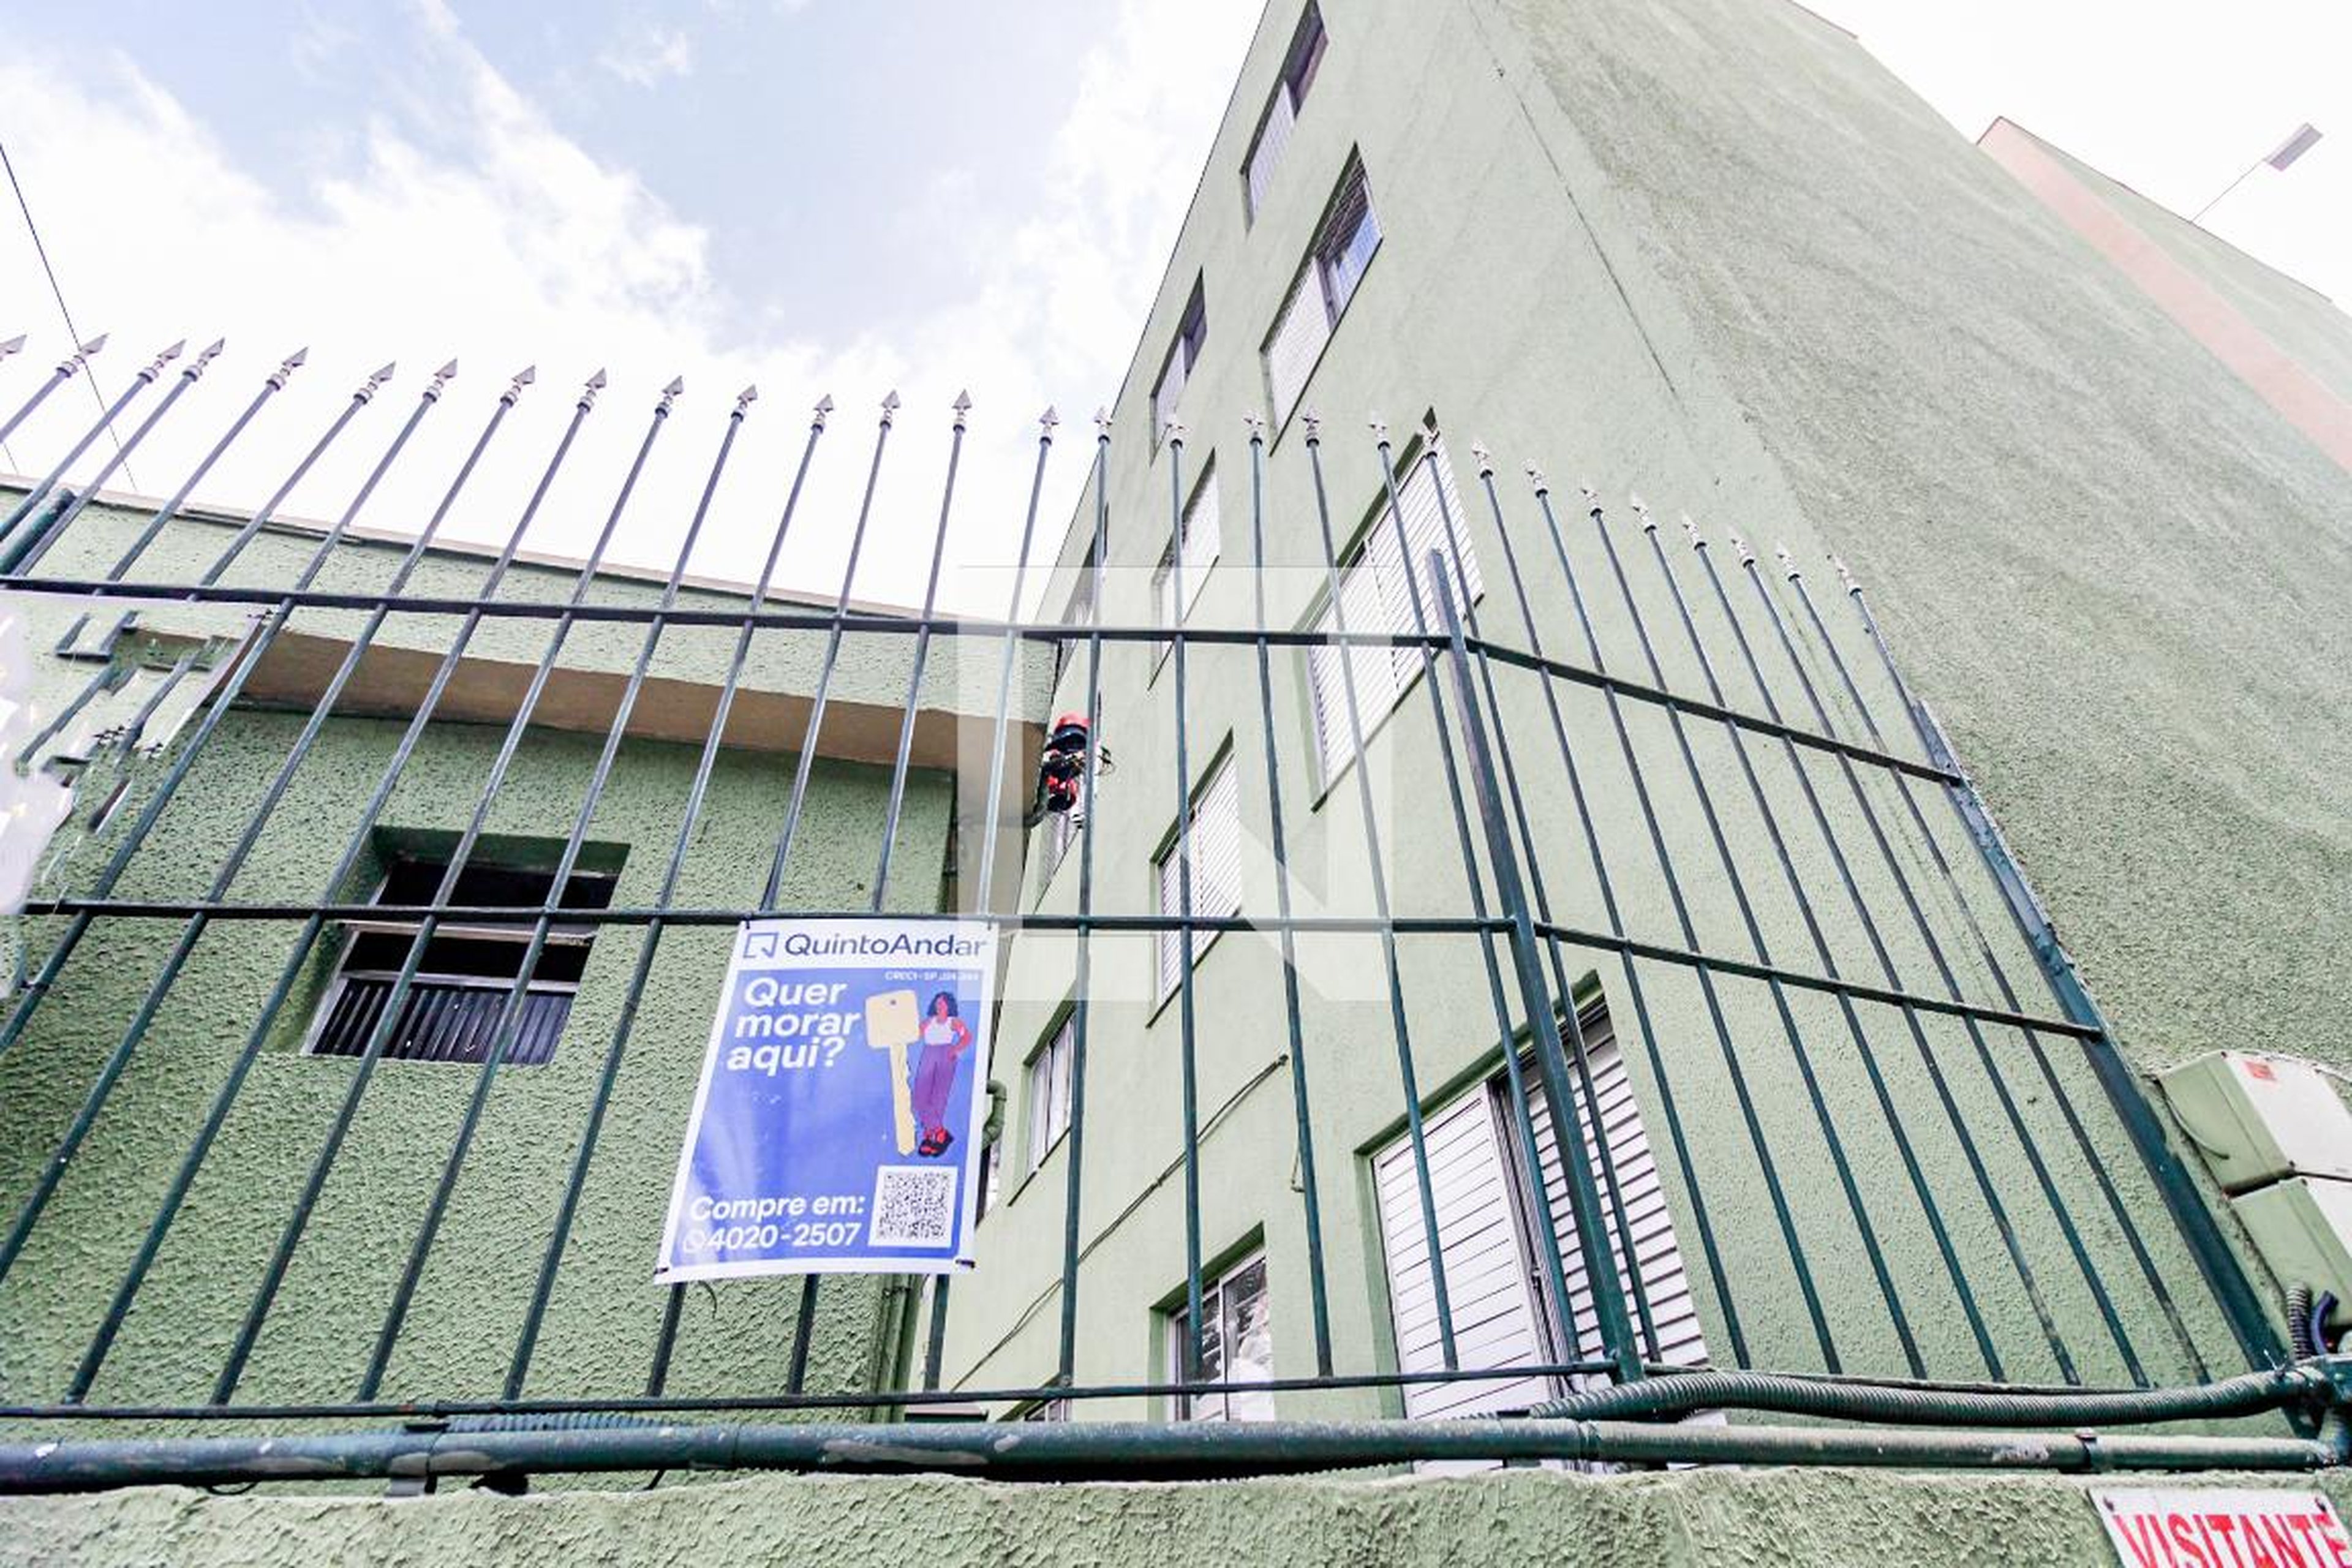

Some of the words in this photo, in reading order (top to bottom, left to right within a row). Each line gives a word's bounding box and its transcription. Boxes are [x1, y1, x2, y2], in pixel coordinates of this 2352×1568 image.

[785, 933, 987, 957] QuintoAndar
[744, 977, 847, 1008] Quer
[735, 1011, 861, 1037] morar
[726, 1036, 845, 1076] aqui?
[689, 1195, 807, 1222] Compre
[812, 1195, 865, 1215] em:
[706, 1223, 862, 1251] 4020-2507
